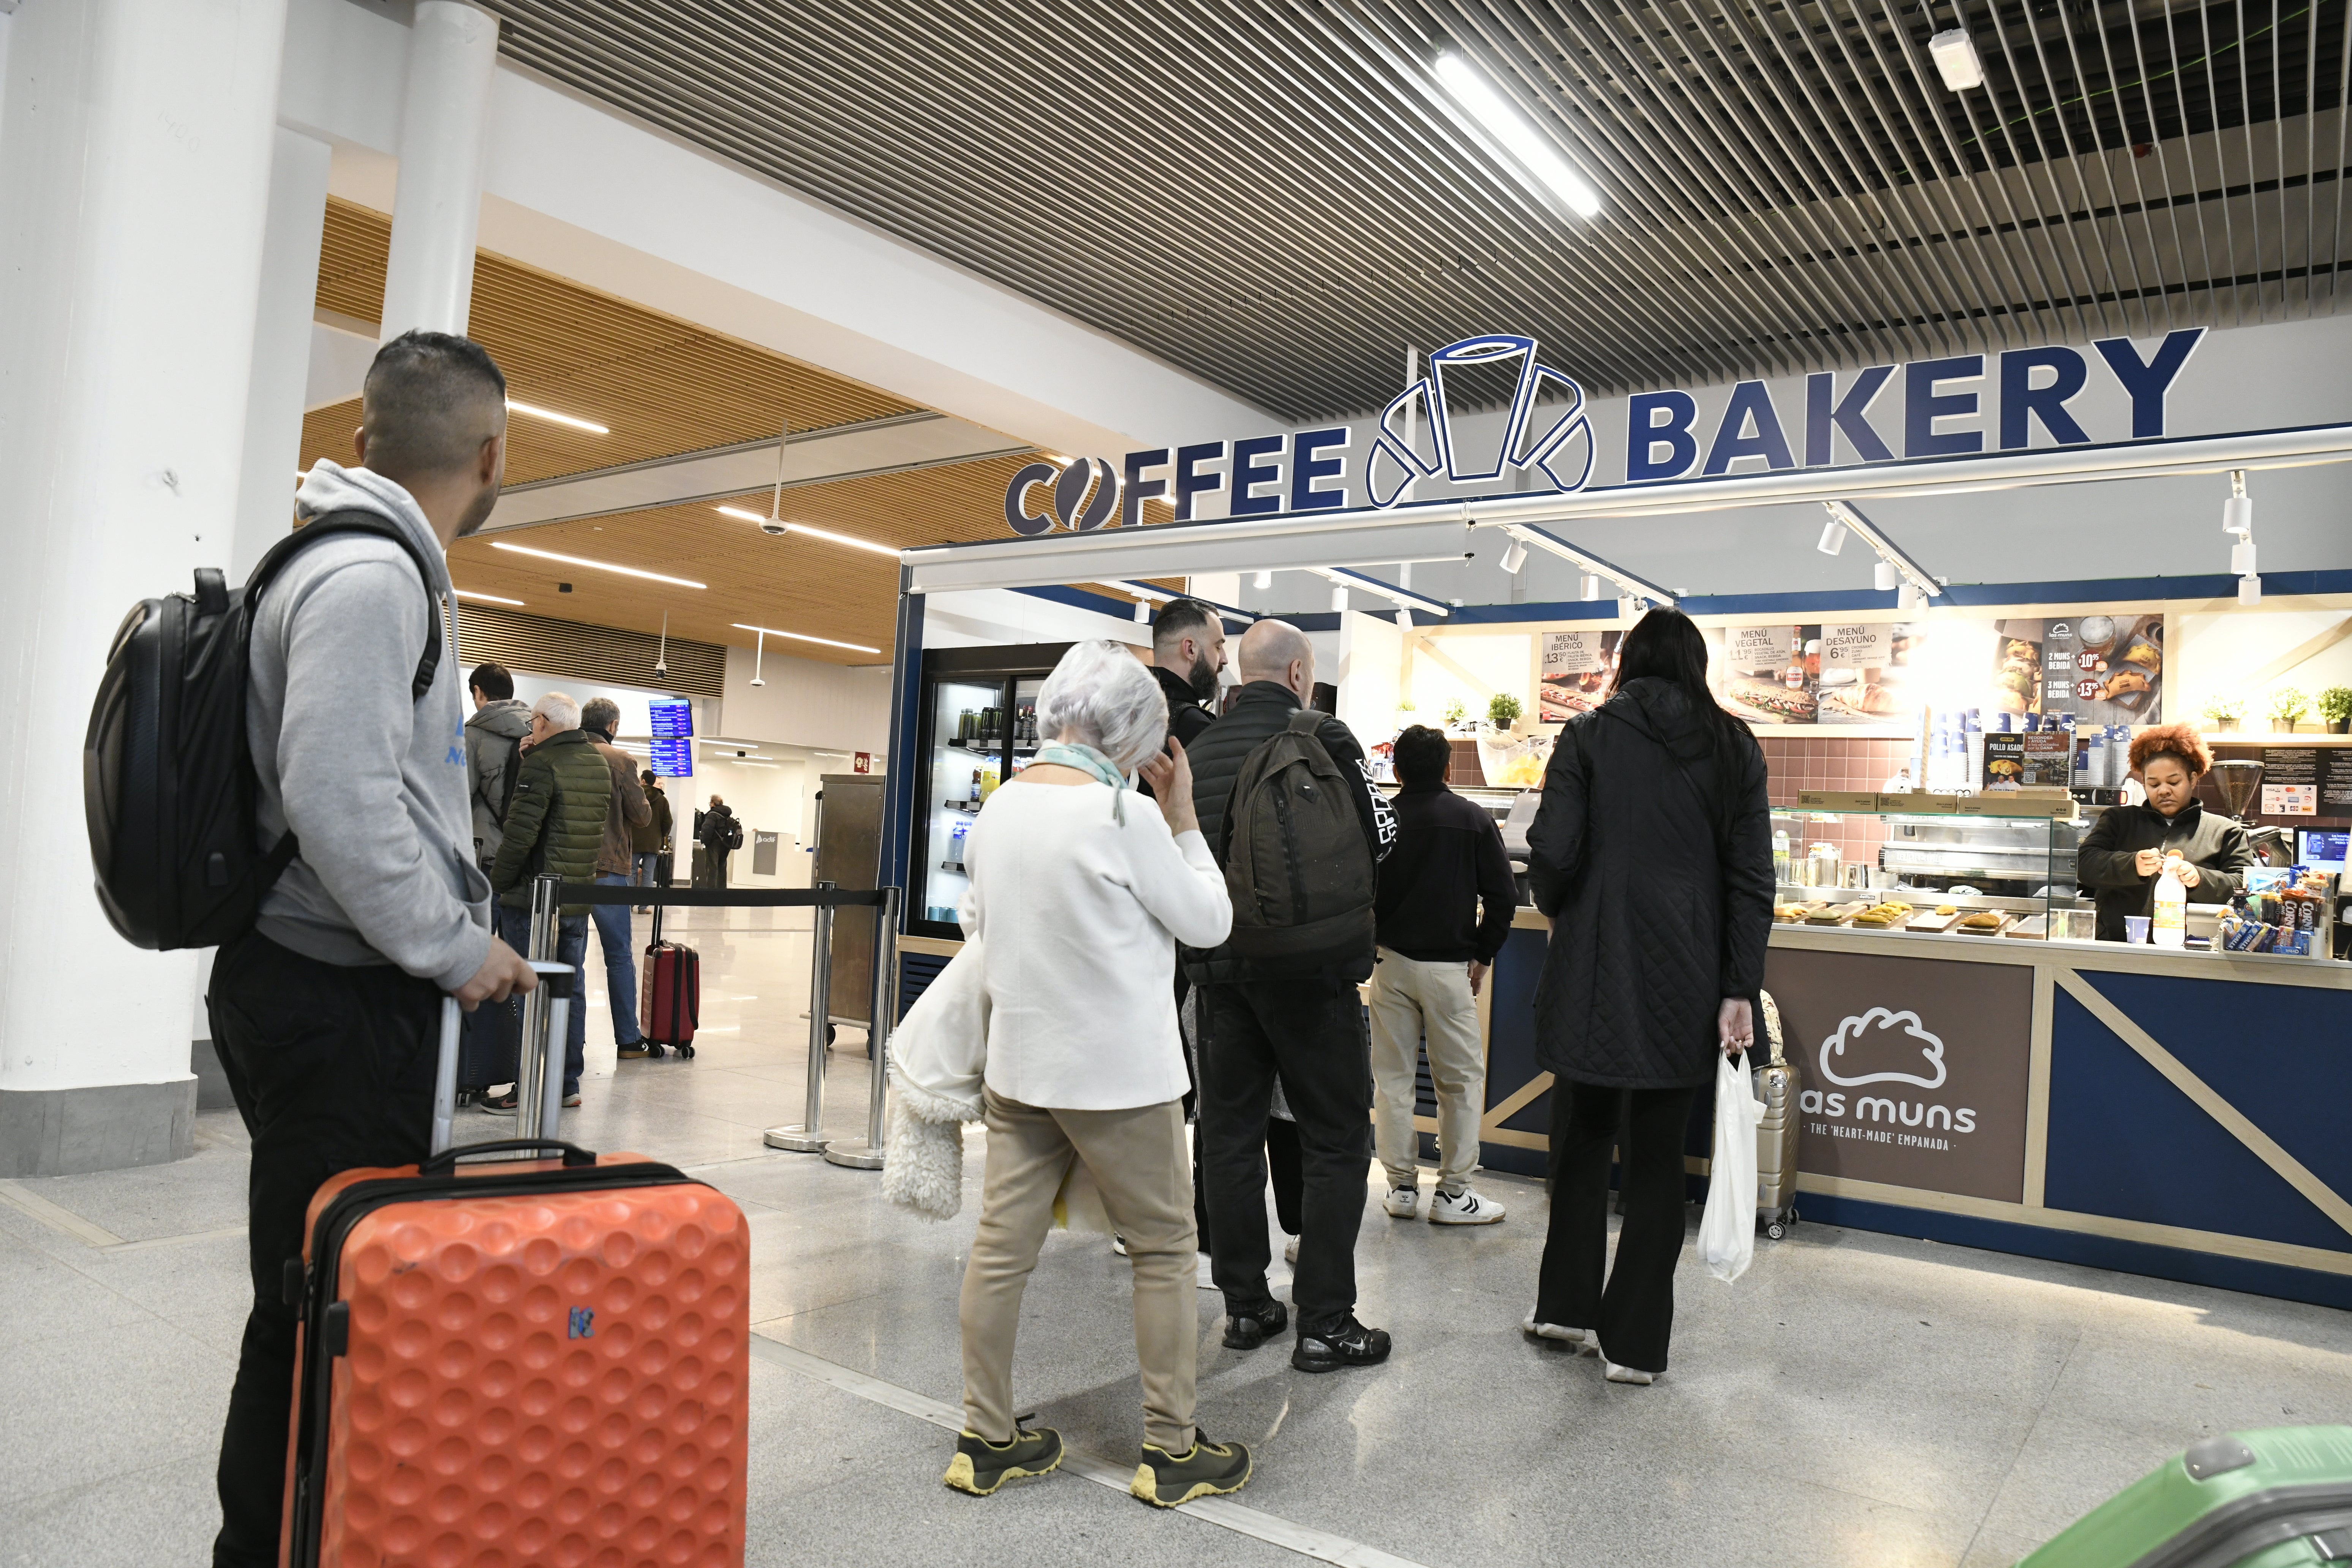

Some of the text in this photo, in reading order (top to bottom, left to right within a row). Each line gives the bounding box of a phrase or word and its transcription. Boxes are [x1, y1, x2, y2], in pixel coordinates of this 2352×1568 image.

[1626, 326, 2209, 484] BAKERY
[1741, 628, 1767, 638] MENÚ
[1837, 626, 1864, 636] MENÚ
[1555, 632, 1579, 642] MENÚ
[1826, 635, 1876, 646] DESAYUNO
[1552, 642, 1582, 651] IBÉRICO
[1736, 638, 1773, 647] VEGETAL
[2049, 661, 2070, 670] BEBIDA
[2227, 933, 2242, 949] HALLS
[2238, 934, 2253, 950] HALLS
[1800, 1089, 1976, 1133] as muns
[1811, 1122, 1949, 1151] THE 'HEART-MADE' EMPANADA
